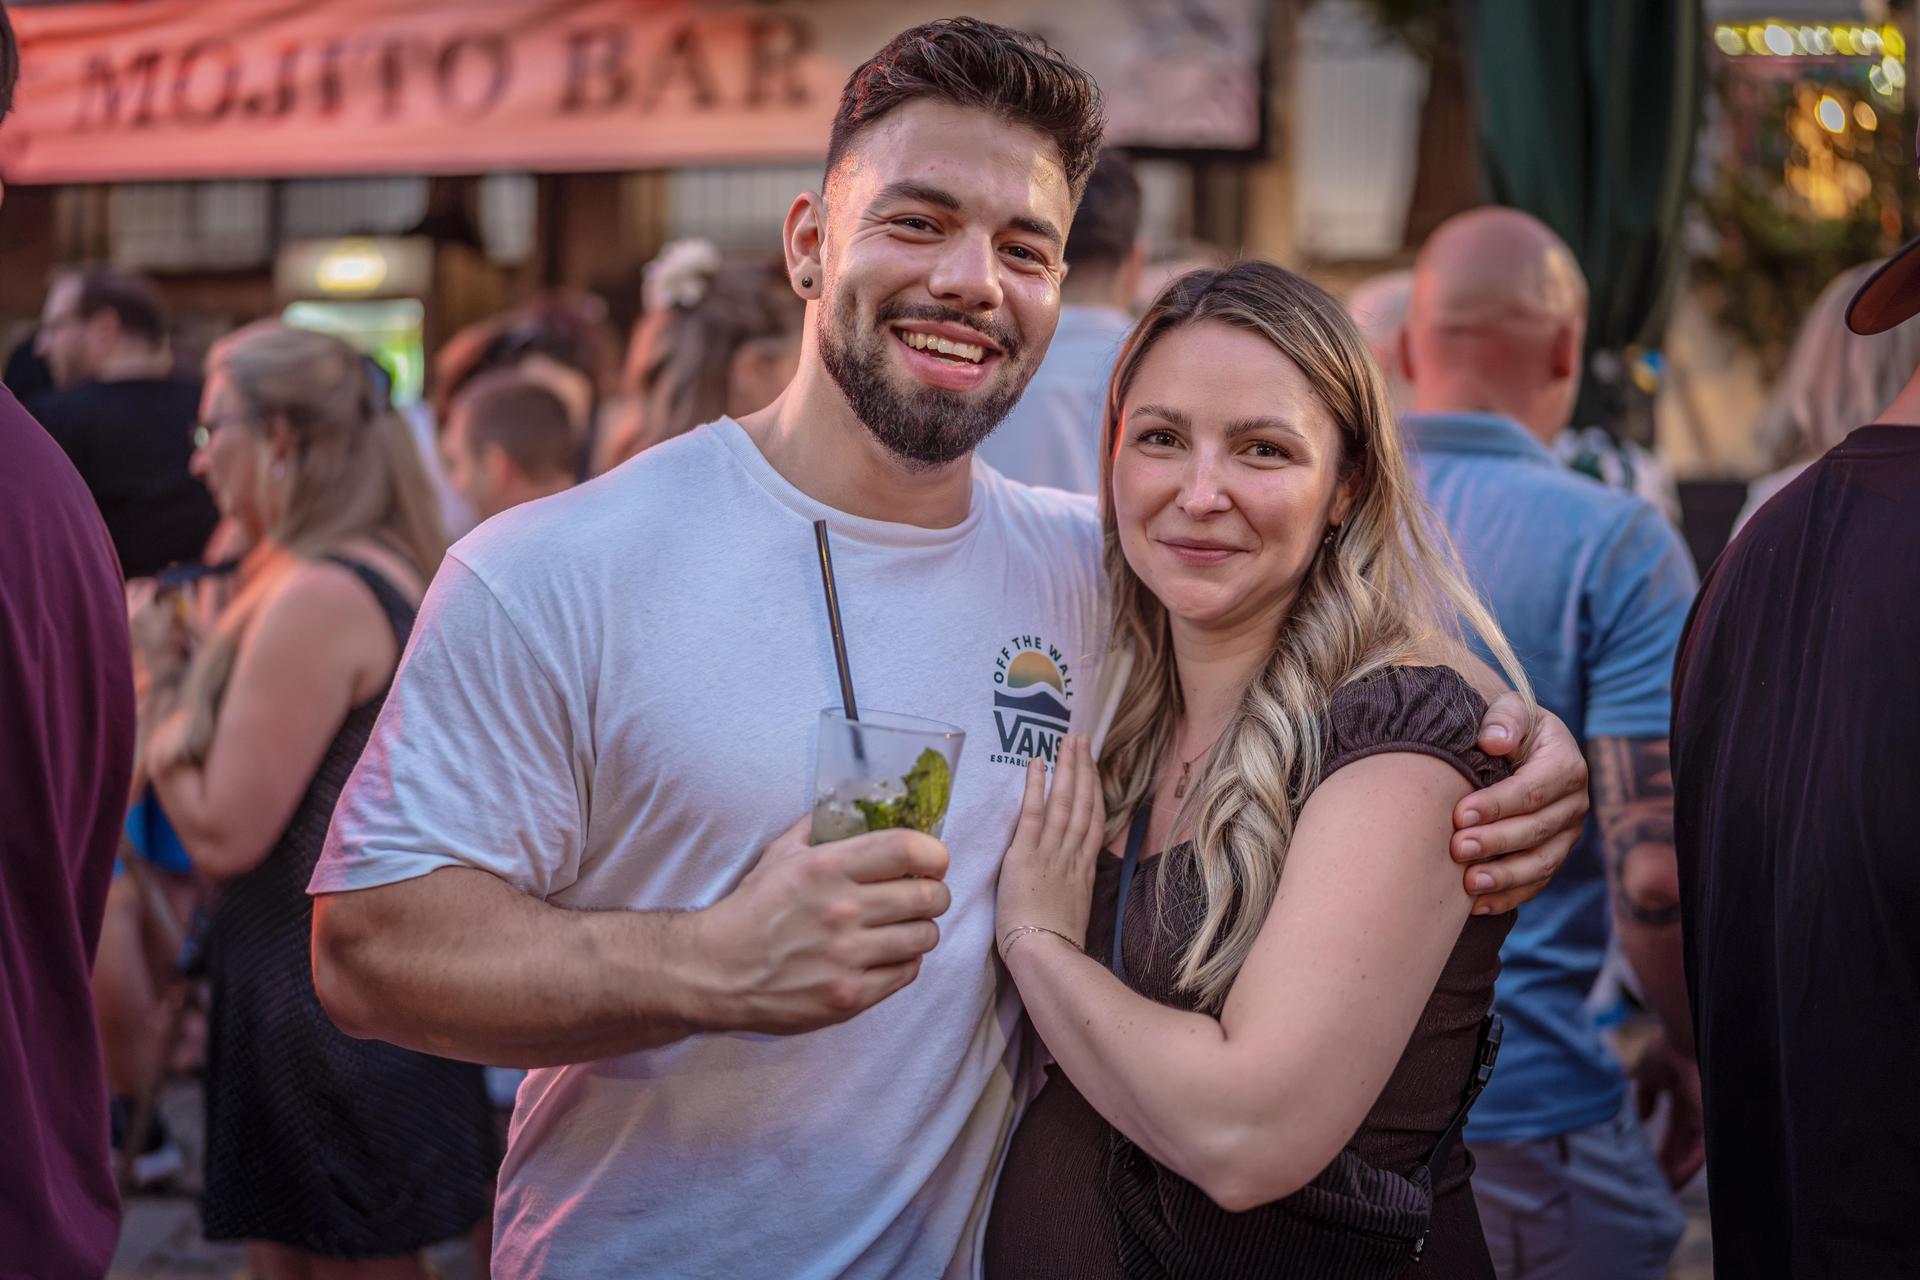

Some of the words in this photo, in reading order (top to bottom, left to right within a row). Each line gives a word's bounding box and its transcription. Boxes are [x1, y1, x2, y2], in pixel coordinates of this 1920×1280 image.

[72, 27, 515, 133] MOJITO
[555, 12, 820, 115] BAR
[993, 647, 1011, 684] OFF
[1012, 634, 1042, 650] THE
[1049, 644, 1074, 700] WALL
[990, 754, 1048, 772] ESTABLID
